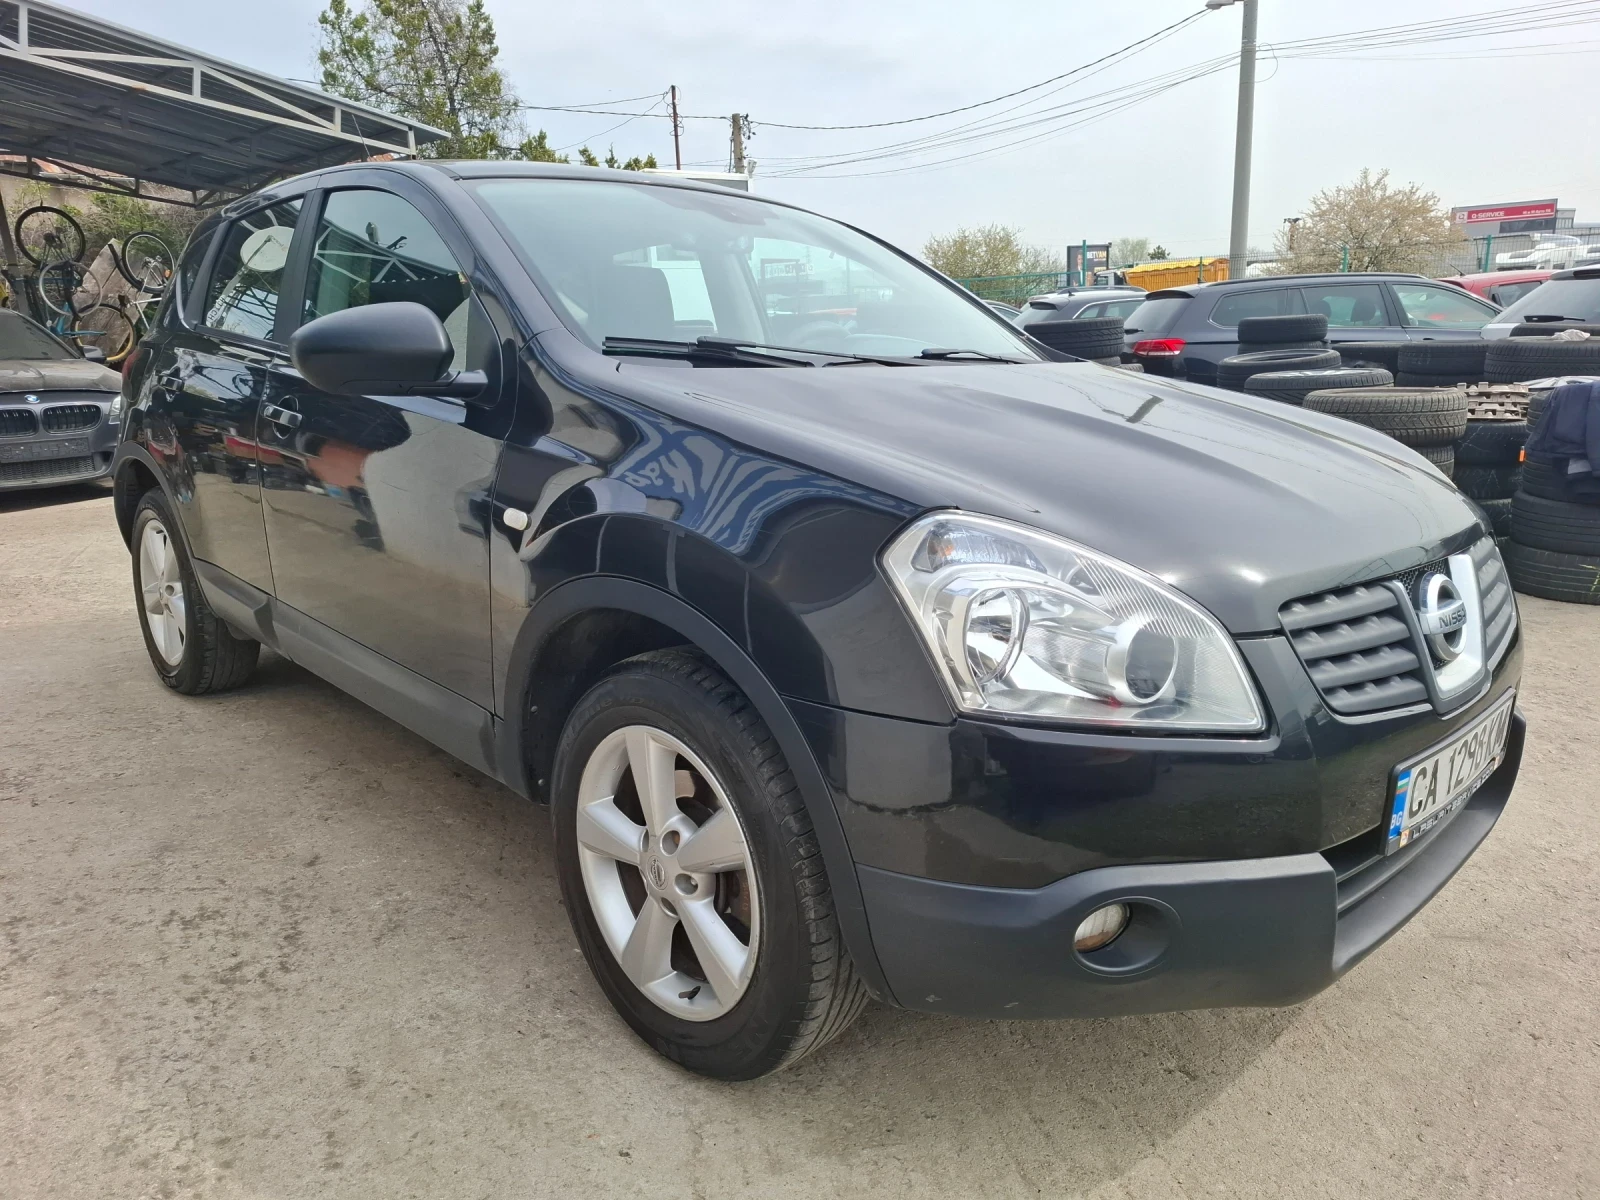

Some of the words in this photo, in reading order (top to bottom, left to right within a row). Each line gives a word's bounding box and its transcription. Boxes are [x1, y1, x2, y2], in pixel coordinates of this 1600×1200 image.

[1438, 608, 1466, 628] NISS
[1447, 724, 1487, 795] 1298
[1390, 811, 1403, 830] BG
